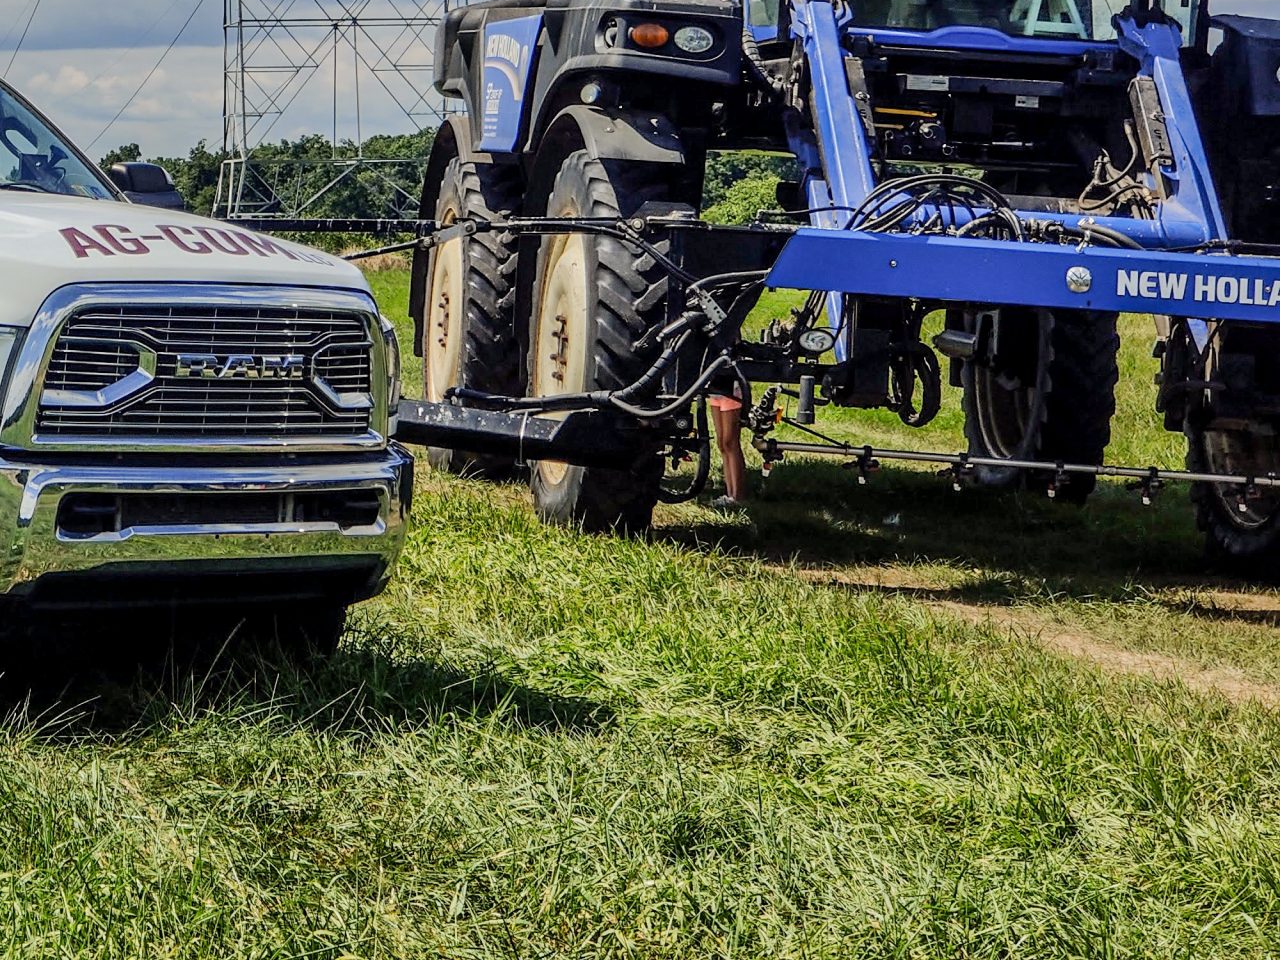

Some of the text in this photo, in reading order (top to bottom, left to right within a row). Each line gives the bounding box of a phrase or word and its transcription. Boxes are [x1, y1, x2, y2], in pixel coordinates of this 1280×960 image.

[59, 224, 300, 261] AG-COM
[1116, 269, 1188, 300] NEW
[176, 354, 305, 379] RAM
